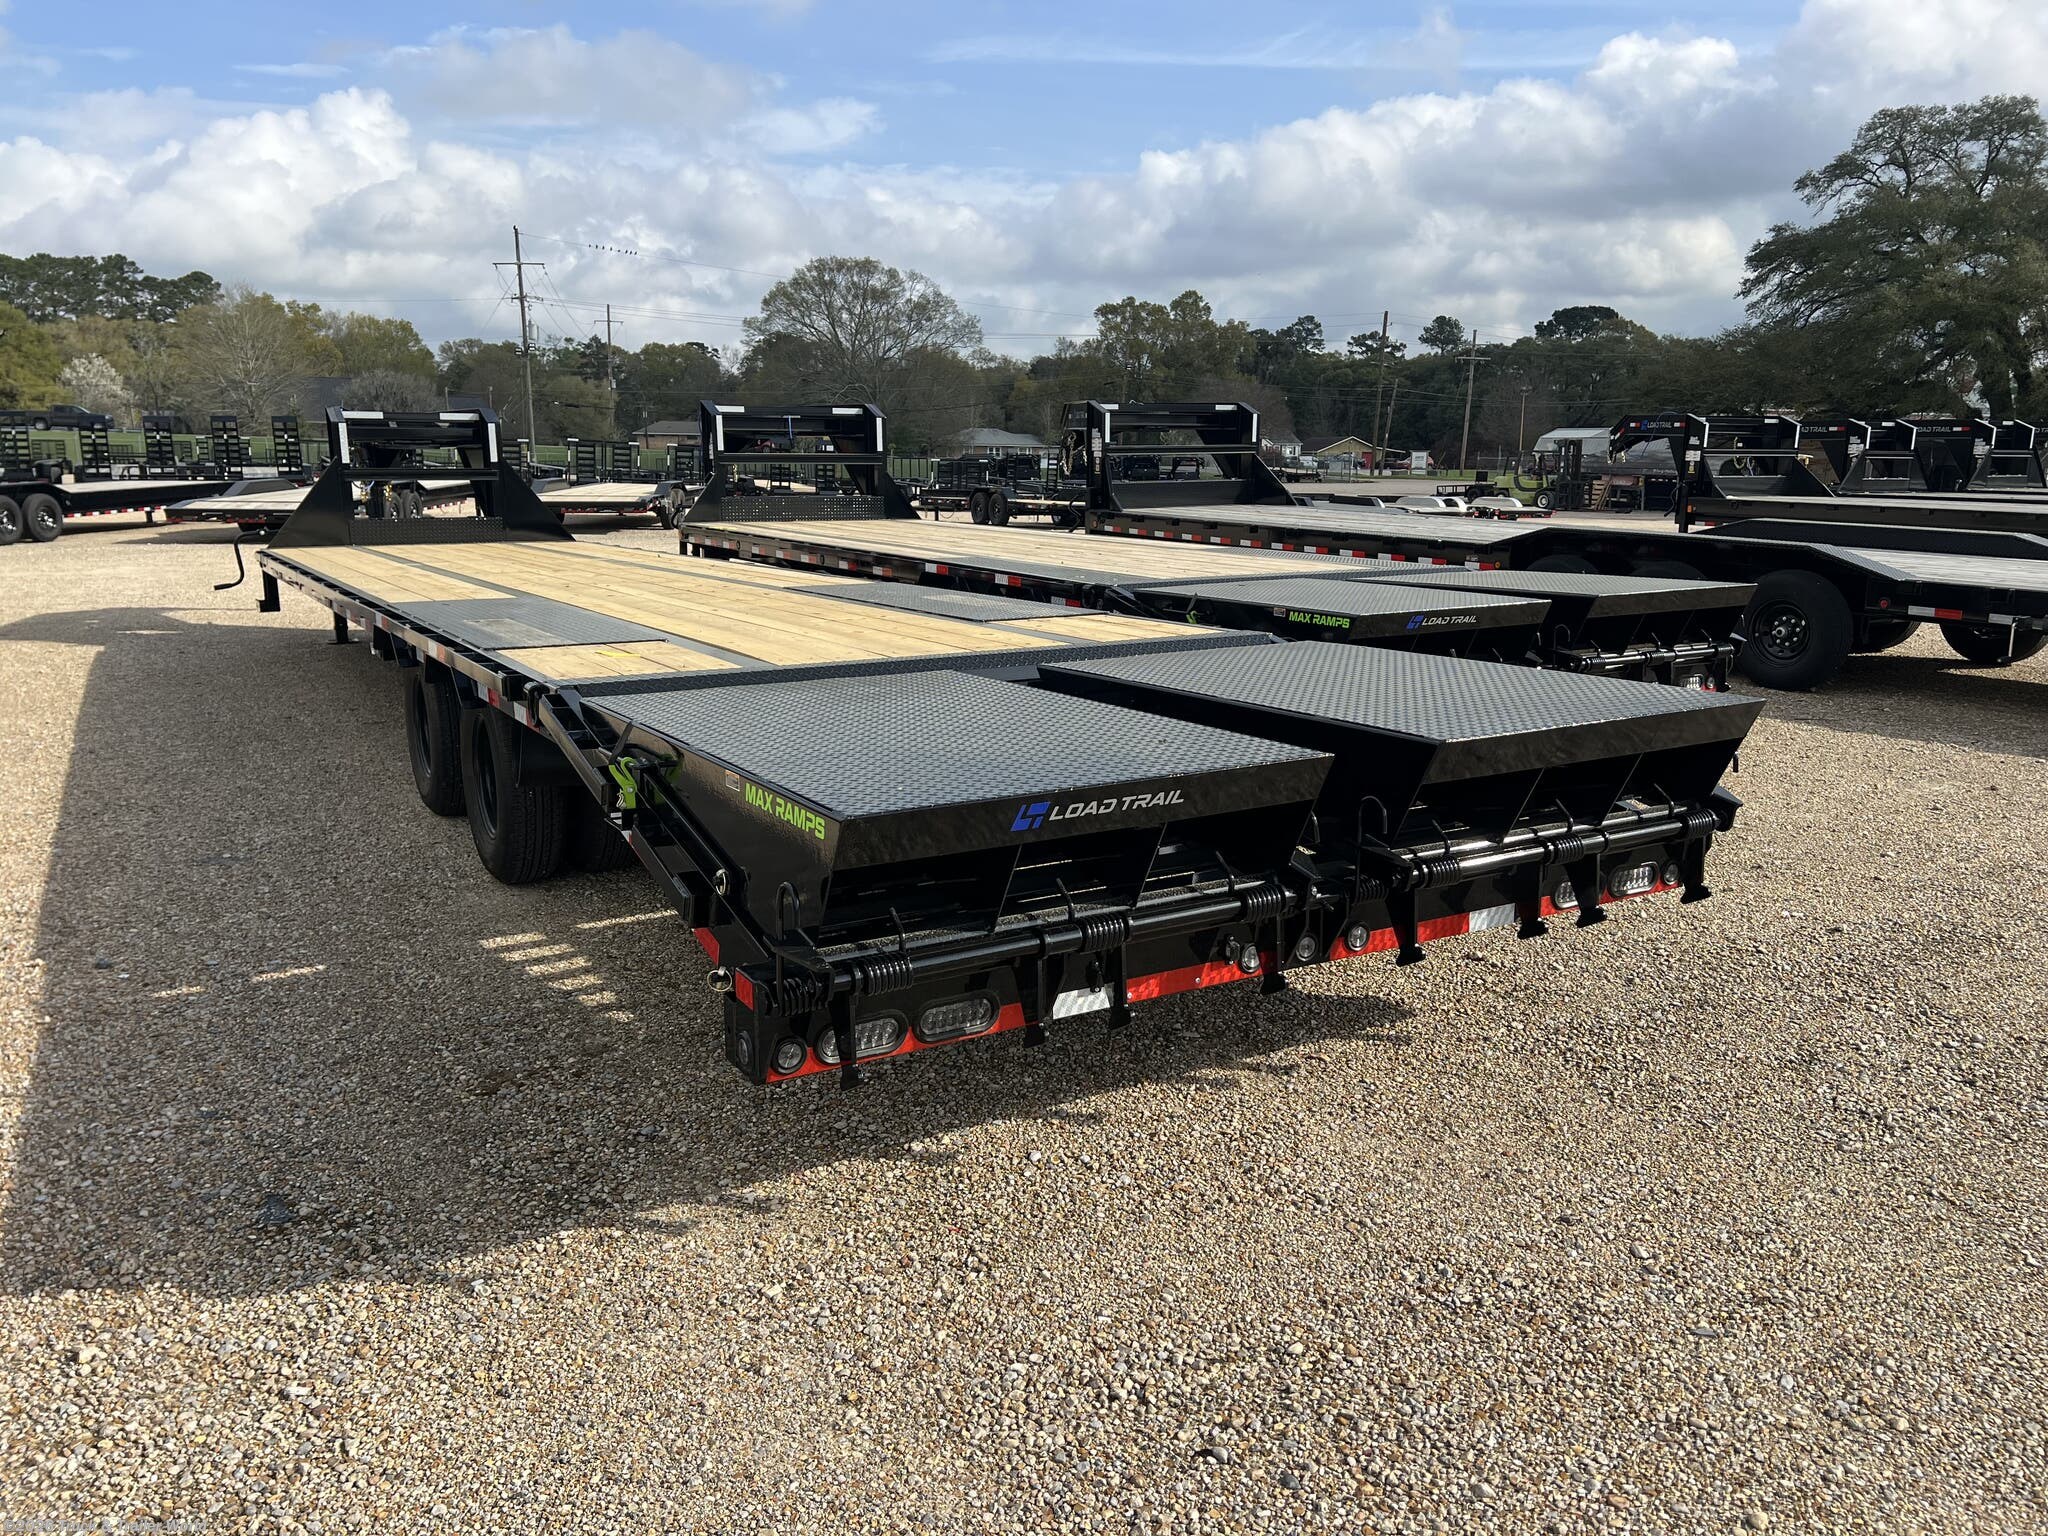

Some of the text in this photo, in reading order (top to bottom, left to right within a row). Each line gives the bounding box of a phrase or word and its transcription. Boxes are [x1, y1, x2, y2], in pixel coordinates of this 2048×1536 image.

[1289, 611, 1311, 624] MAX
[1312, 614, 1350, 629] RAMPS
[1421, 616, 1450, 626] LOAD
[1450, 615, 1477, 624] TRAIL
[745, 782, 825, 840] MAX RAMPS
[1049, 799, 1118, 821] LOAD
[1121, 789, 1185, 811] TRAIL
